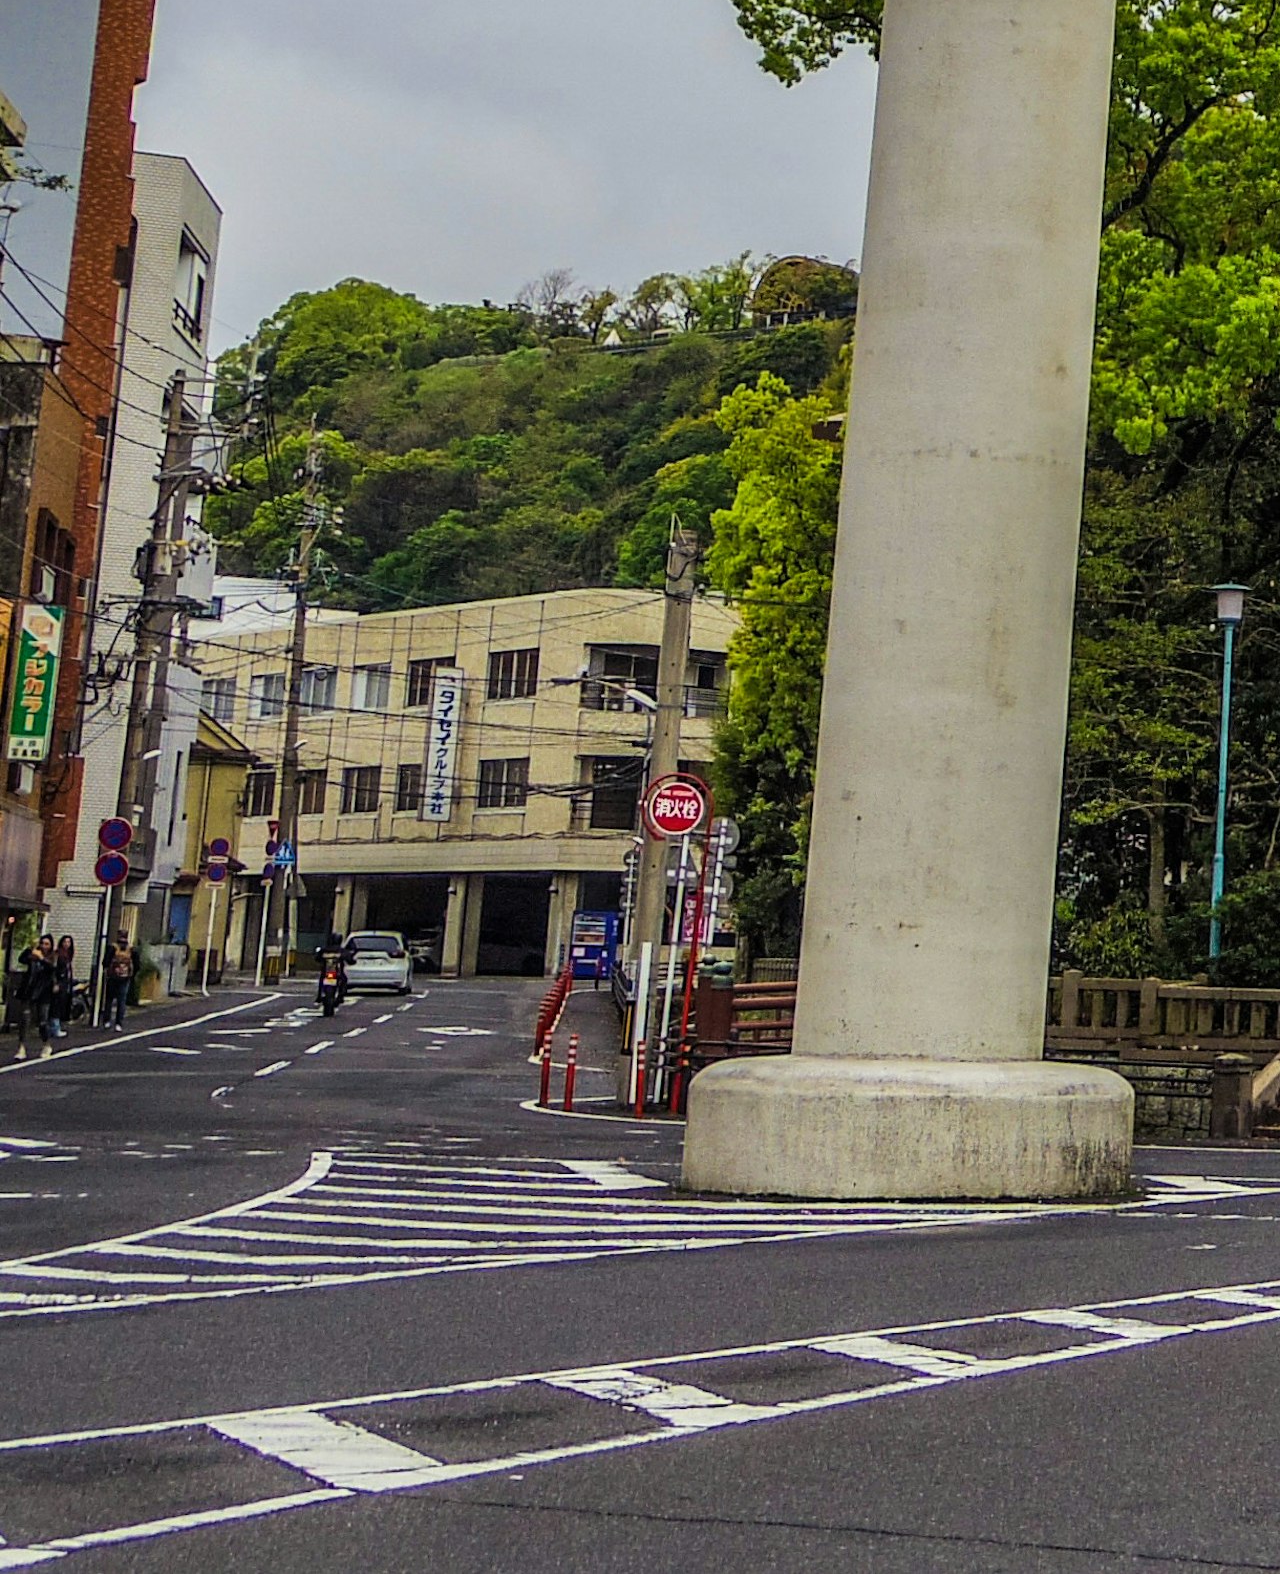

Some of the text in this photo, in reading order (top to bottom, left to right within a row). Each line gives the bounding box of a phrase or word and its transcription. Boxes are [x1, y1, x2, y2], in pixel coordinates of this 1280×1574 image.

[20, 639, 48, 732] フジカラー
[430, 690, 455, 815] タイセイグループ本社
[655, 797, 698, 819] 消火栓
